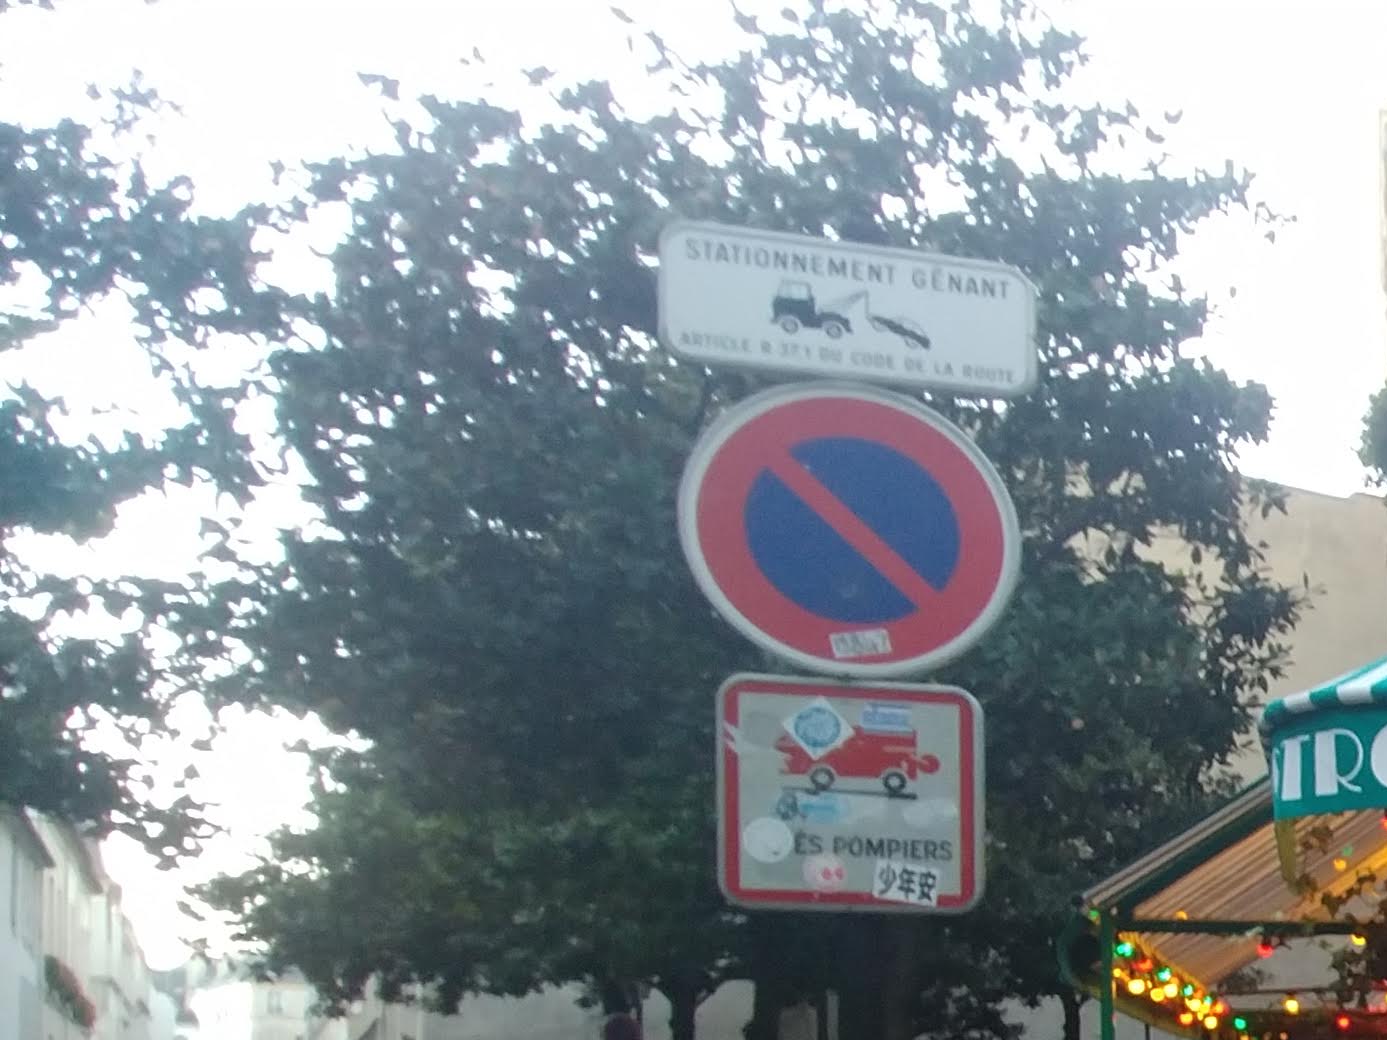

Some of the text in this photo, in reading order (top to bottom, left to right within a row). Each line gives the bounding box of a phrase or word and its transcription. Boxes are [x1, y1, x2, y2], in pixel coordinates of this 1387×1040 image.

[685, 238, 1010, 300] STATIONNEMENT GÊNANT
[680, 331, 750, 353] ARTICLE
[850, 351, 894, 370] CODE
[904, 355, 926, 373] DE
[933, 360, 954, 377] LA
[961, 364, 1014, 385] ROUTE
[832, 834, 954, 862] POMPIERS
